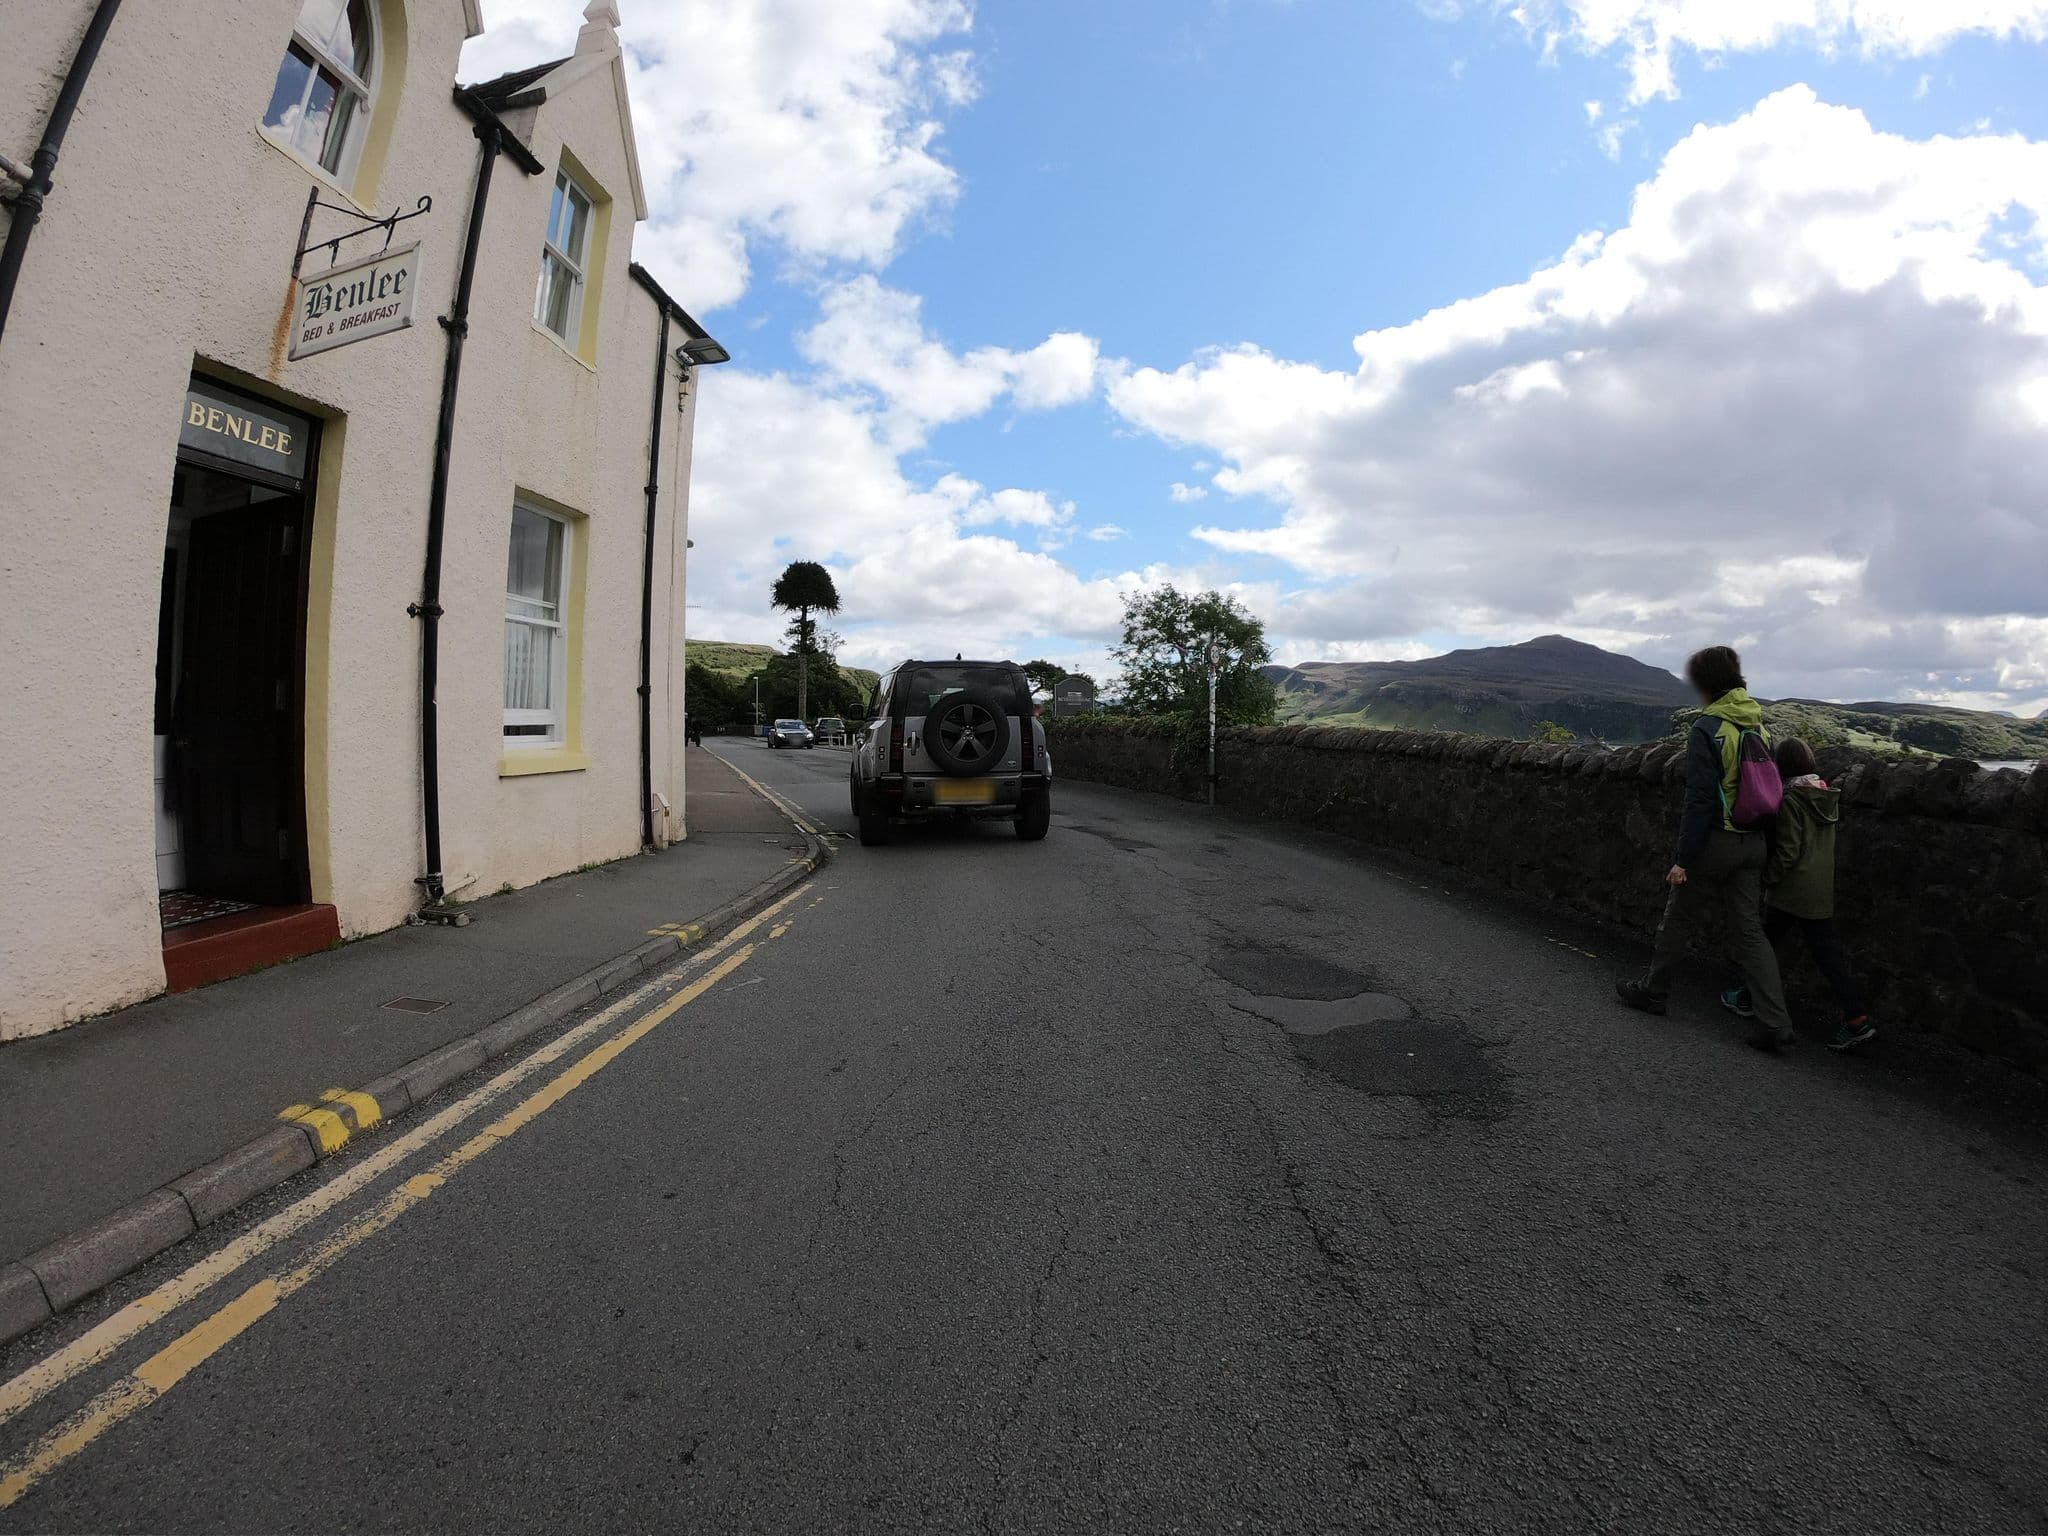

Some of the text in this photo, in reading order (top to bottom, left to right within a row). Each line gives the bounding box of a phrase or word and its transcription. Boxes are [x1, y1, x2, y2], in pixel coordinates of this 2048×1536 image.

[302, 302, 401, 342] BED & BREAKFAST
[303, 266, 407, 327] Benlee
[187, 401, 292, 455] BENLEE
